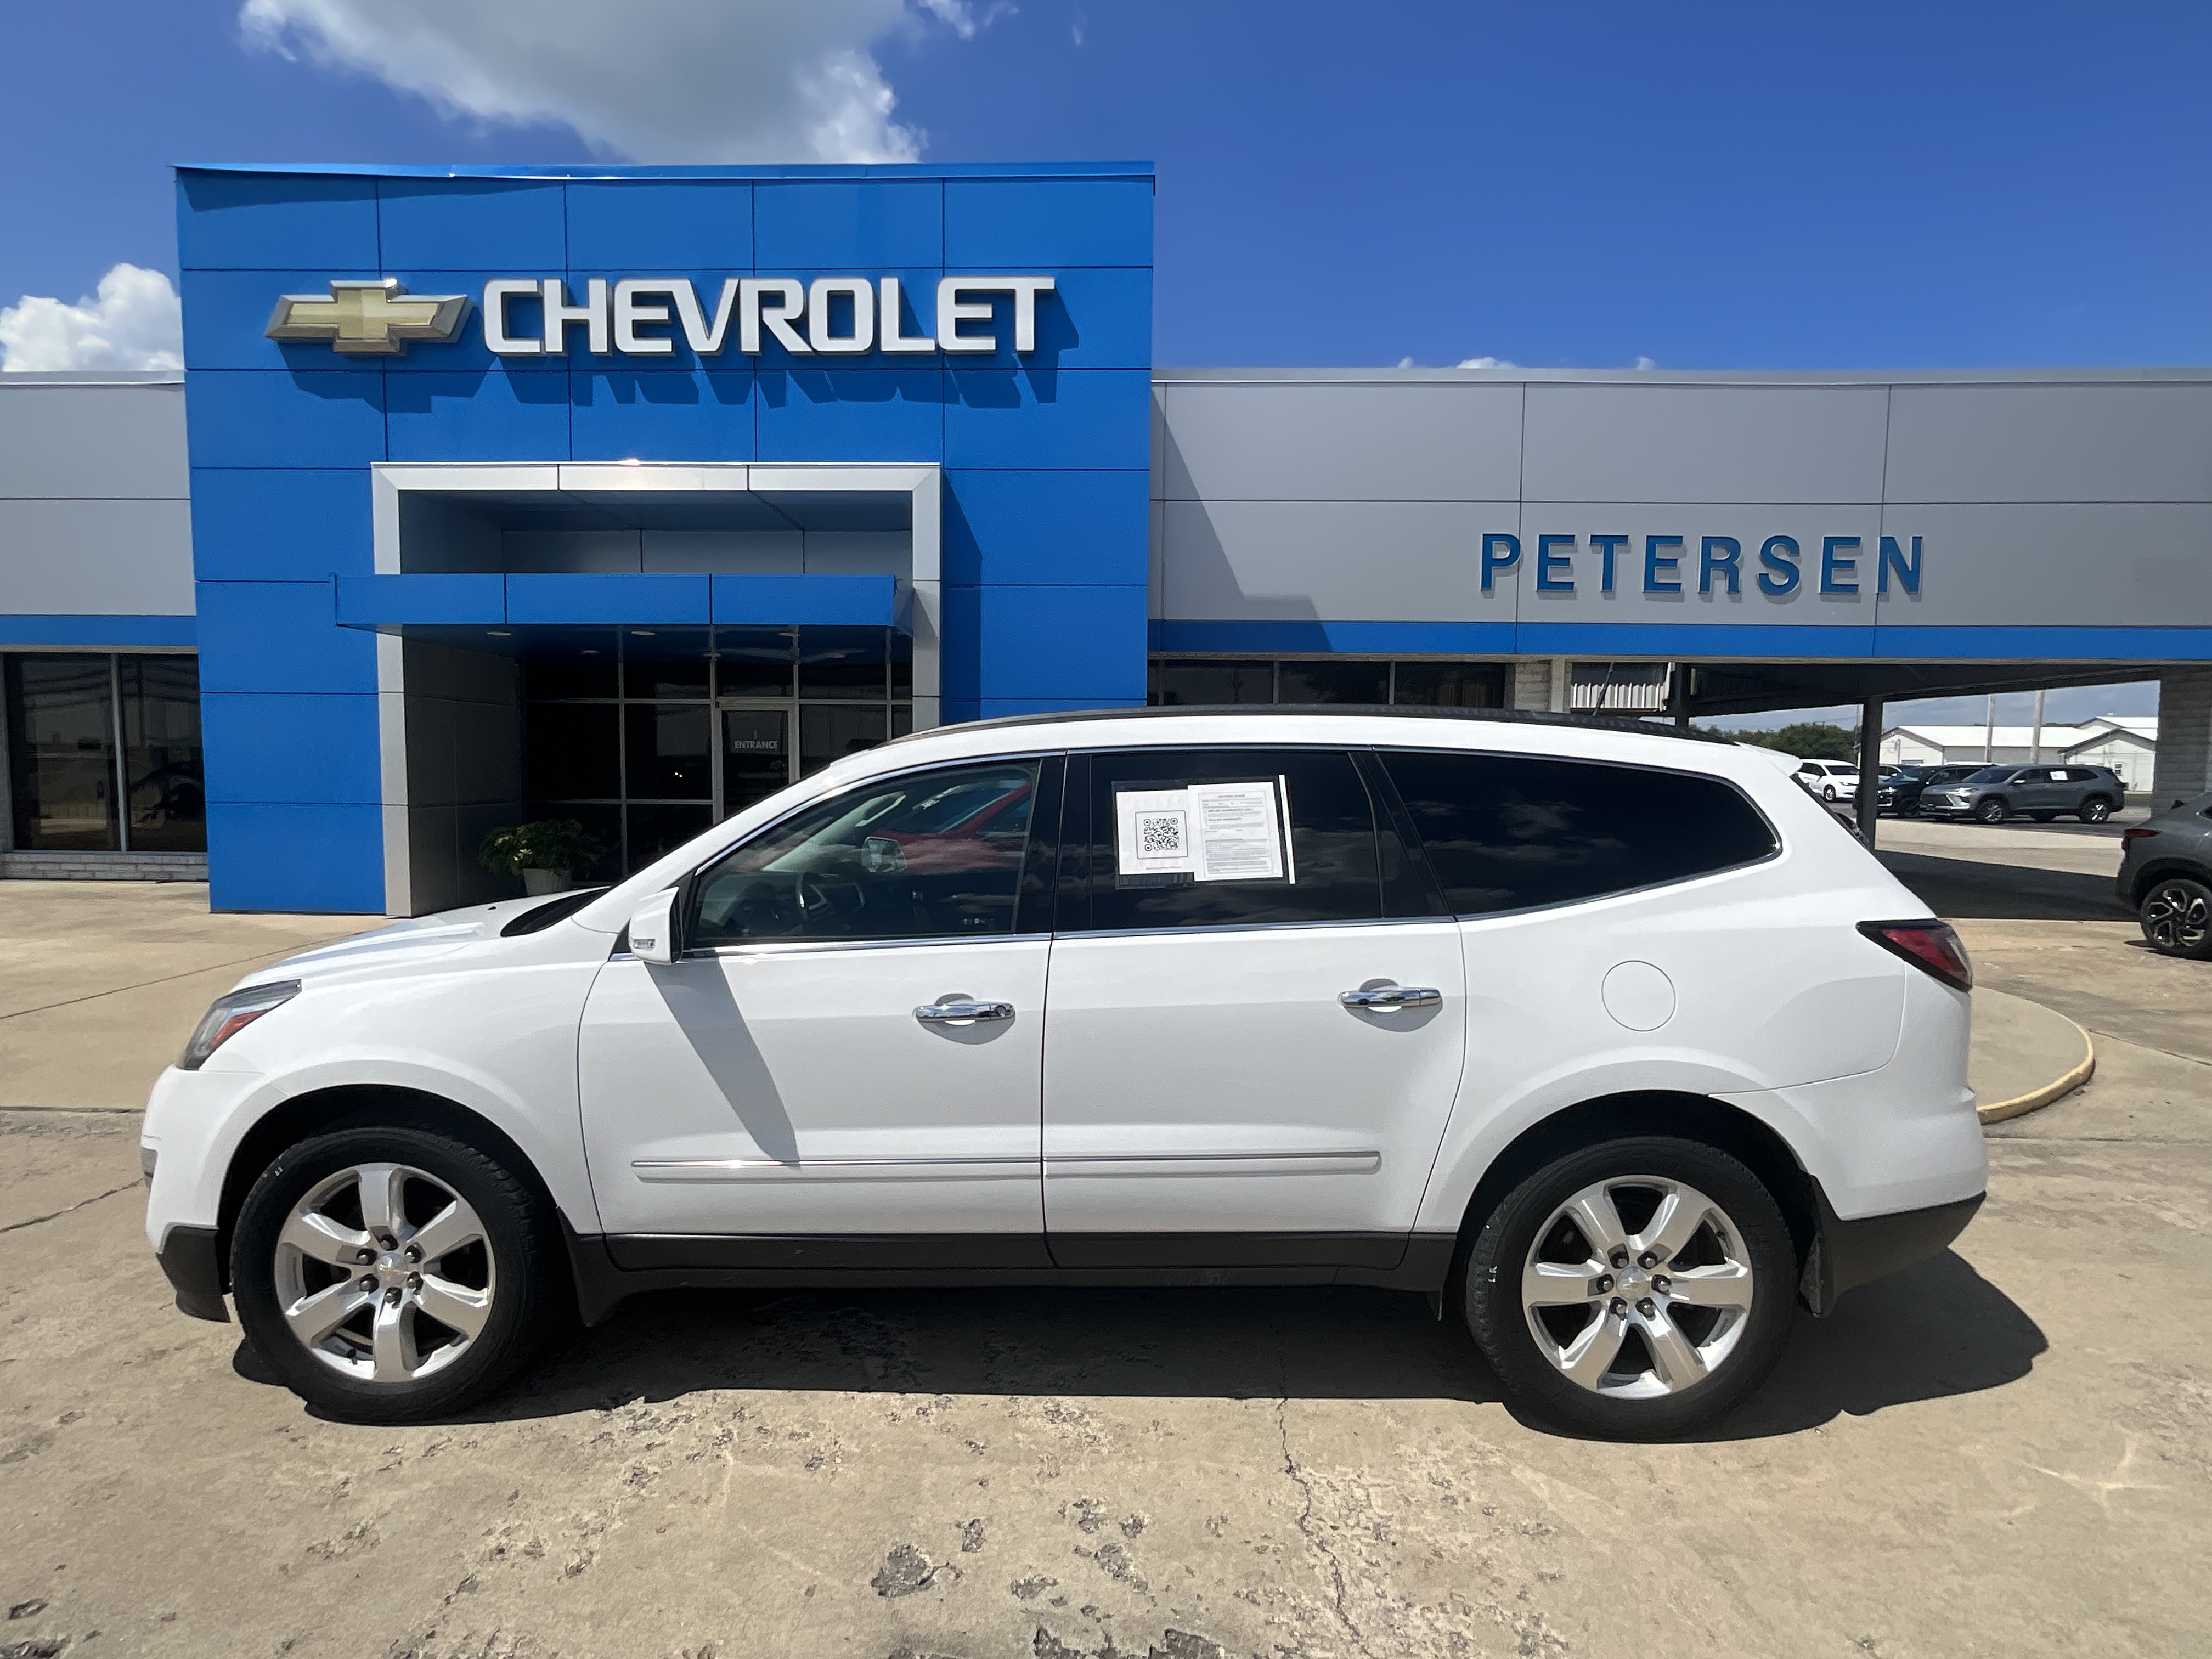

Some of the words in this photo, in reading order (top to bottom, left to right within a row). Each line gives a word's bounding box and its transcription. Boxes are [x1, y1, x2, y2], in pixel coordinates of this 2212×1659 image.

[483, 277, 1055, 354] CHEVROLET
[1480, 532, 1923, 595] PETERSEN
[735, 741, 778, 749] ENTRANCE
